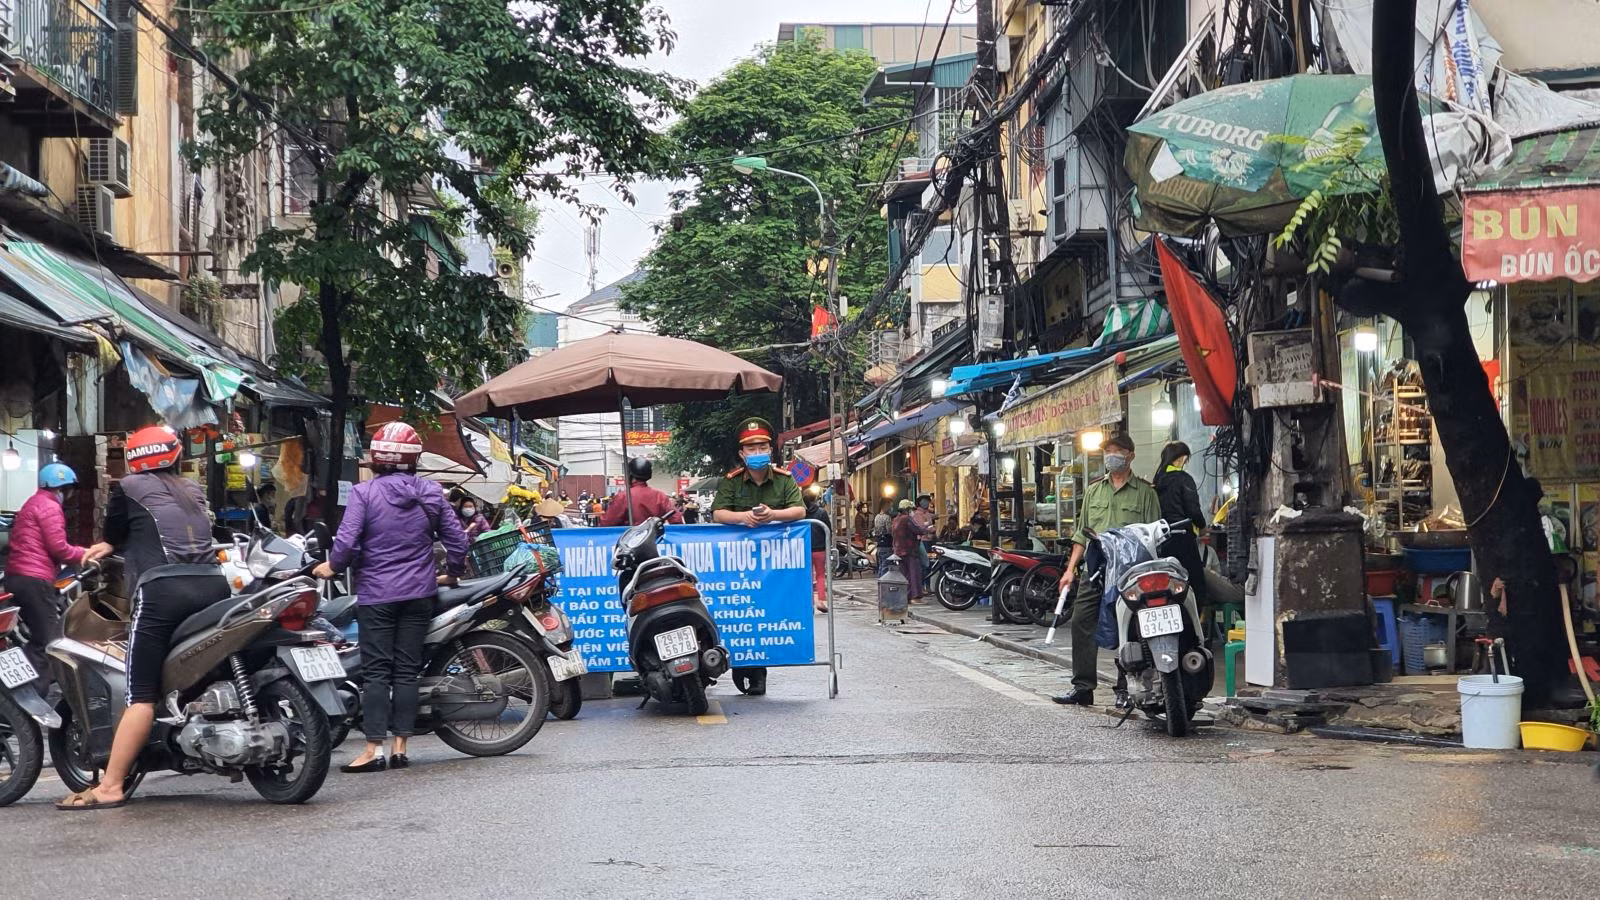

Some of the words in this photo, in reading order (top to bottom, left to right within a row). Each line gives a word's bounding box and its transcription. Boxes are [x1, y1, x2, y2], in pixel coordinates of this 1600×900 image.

[1157, 112, 1269, 152] TUBORG
[1472, 198, 1578, 241] BÚN
[1501, 247, 1554, 278] BÚN
[1573, 388, 1598, 400] FISH
[1530, 397, 1569, 435] NOODLES
[127, 443, 171, 460] GAMUDA
[565, 540, 607, 578] NHÂN
[681, 542, 715, 573] MUA
[717, 537, 757, 578] THỰC
[761, 526, 805, 570] PHẨM
[568, 587, 592, 599] TẠI
[604, 600, 623, 611] QU
[718, 594, 756, 606] TIỆN.
[601, 614, 628, 624] TRA
[1145, 608, 1174, 623] 29-B1
[573, 627, 604, 639] ƯỚC
[1144, 619, 1180, 636] 934.15
[664, 640, 692, 656] 5678
[730, 637, 755, 647] KHI
[760, 636, 795, 646] MUA
[300, 648, 332, 663] 29-C1
